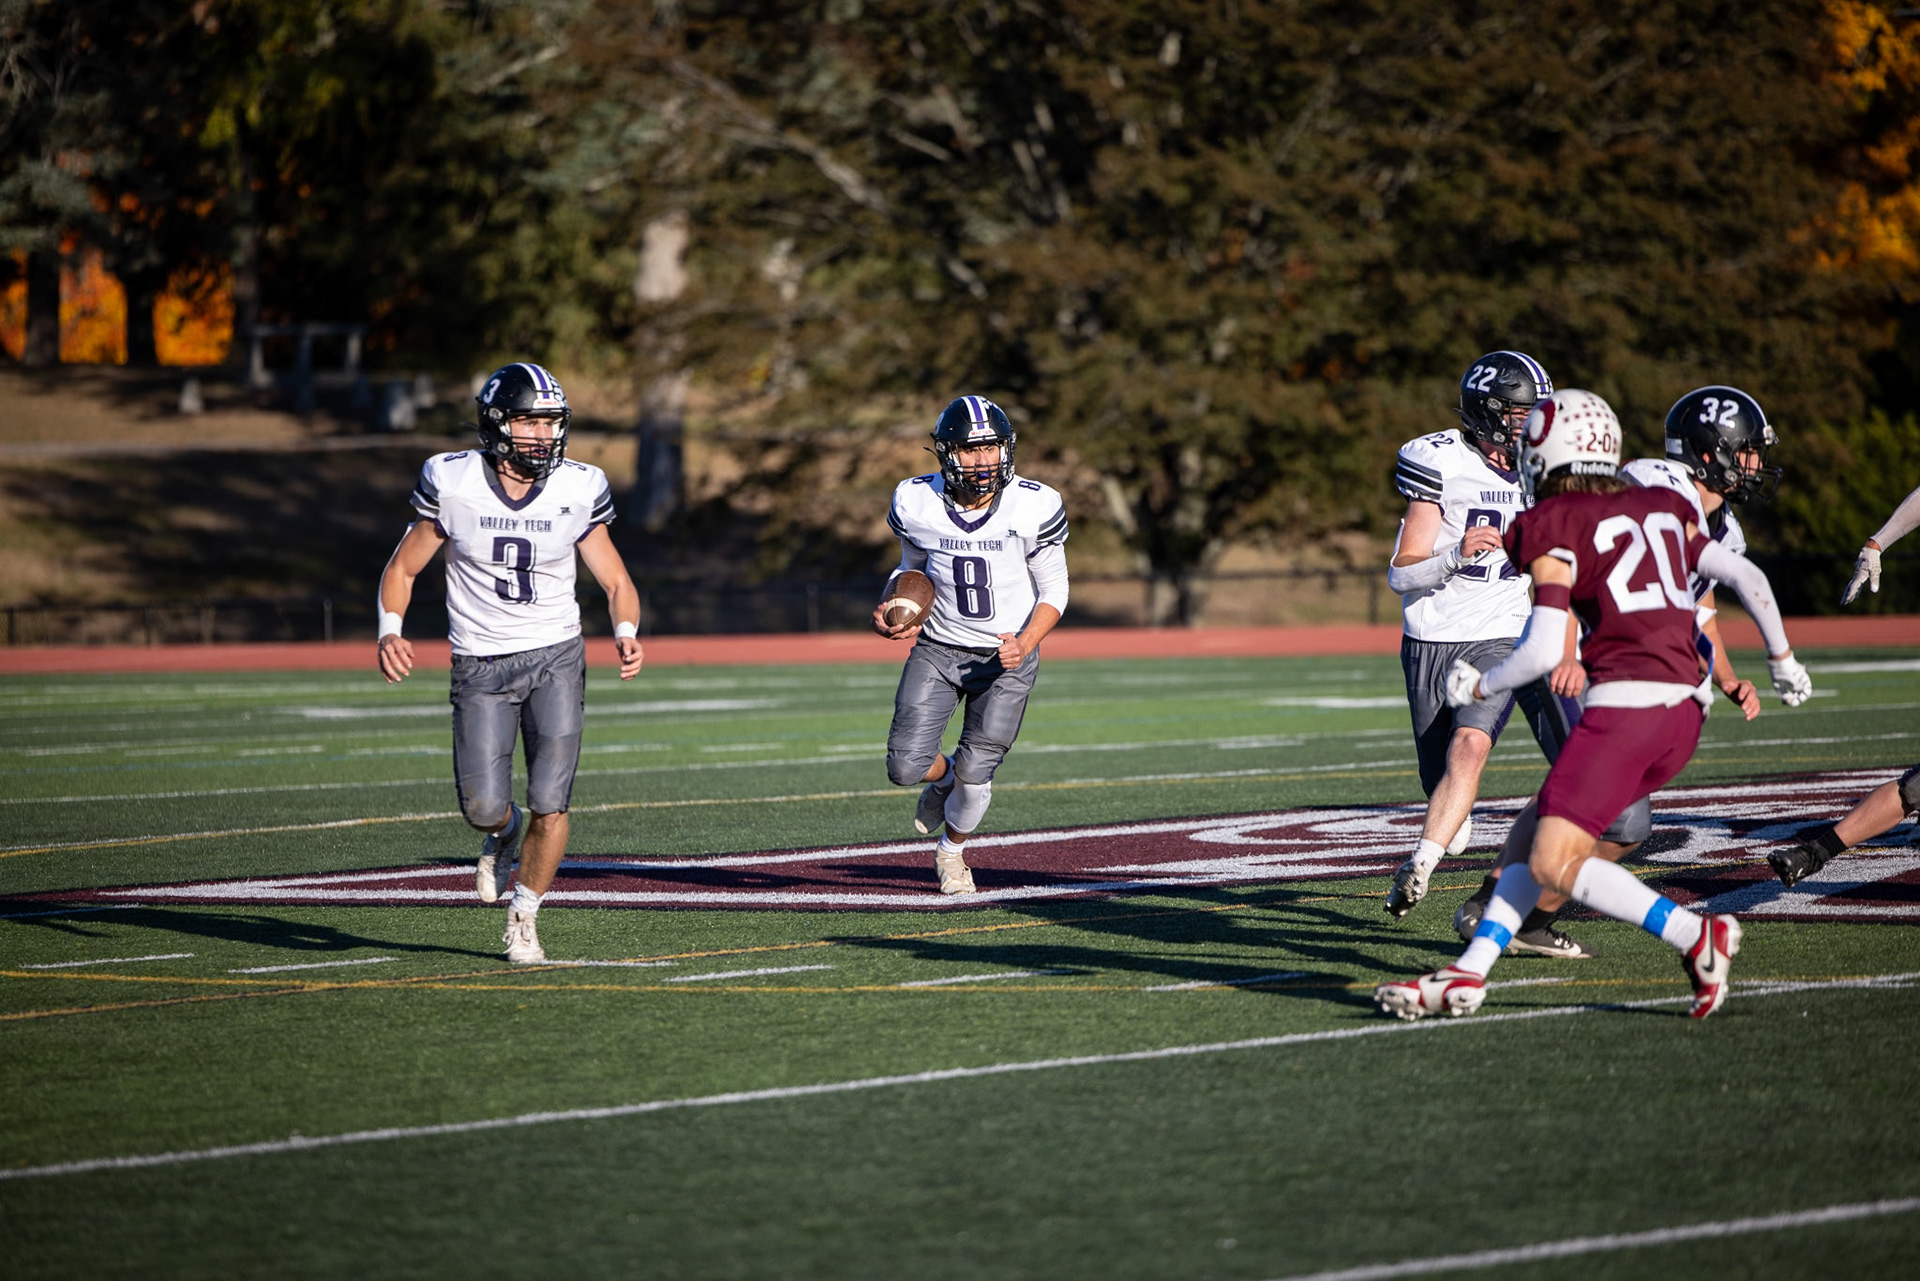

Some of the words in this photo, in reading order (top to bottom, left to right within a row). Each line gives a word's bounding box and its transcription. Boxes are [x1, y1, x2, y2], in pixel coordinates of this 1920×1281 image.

[1466, 364, 1498, 393] 22
[483, 379, 501, 403] 3
[1699, 397, 1739, 429] 32
[1570, 461, 1617, 477] Riddell
[912, 474, 935, 485] 8
[1018, 480, 1041, 492] 8
[1480, 490, 1514, 504] VALLEY
[480, 516, 519, 532] VALLEY
[525, 519, 552, 533] TECH
[939, 537, 972, 552] VALLEY
[977, 540, 1003, 552] TECH
[492, 536, 537, 605] 3
[1593, 511, 1696, 614] 20
[952, 556, 994, 622] 8
